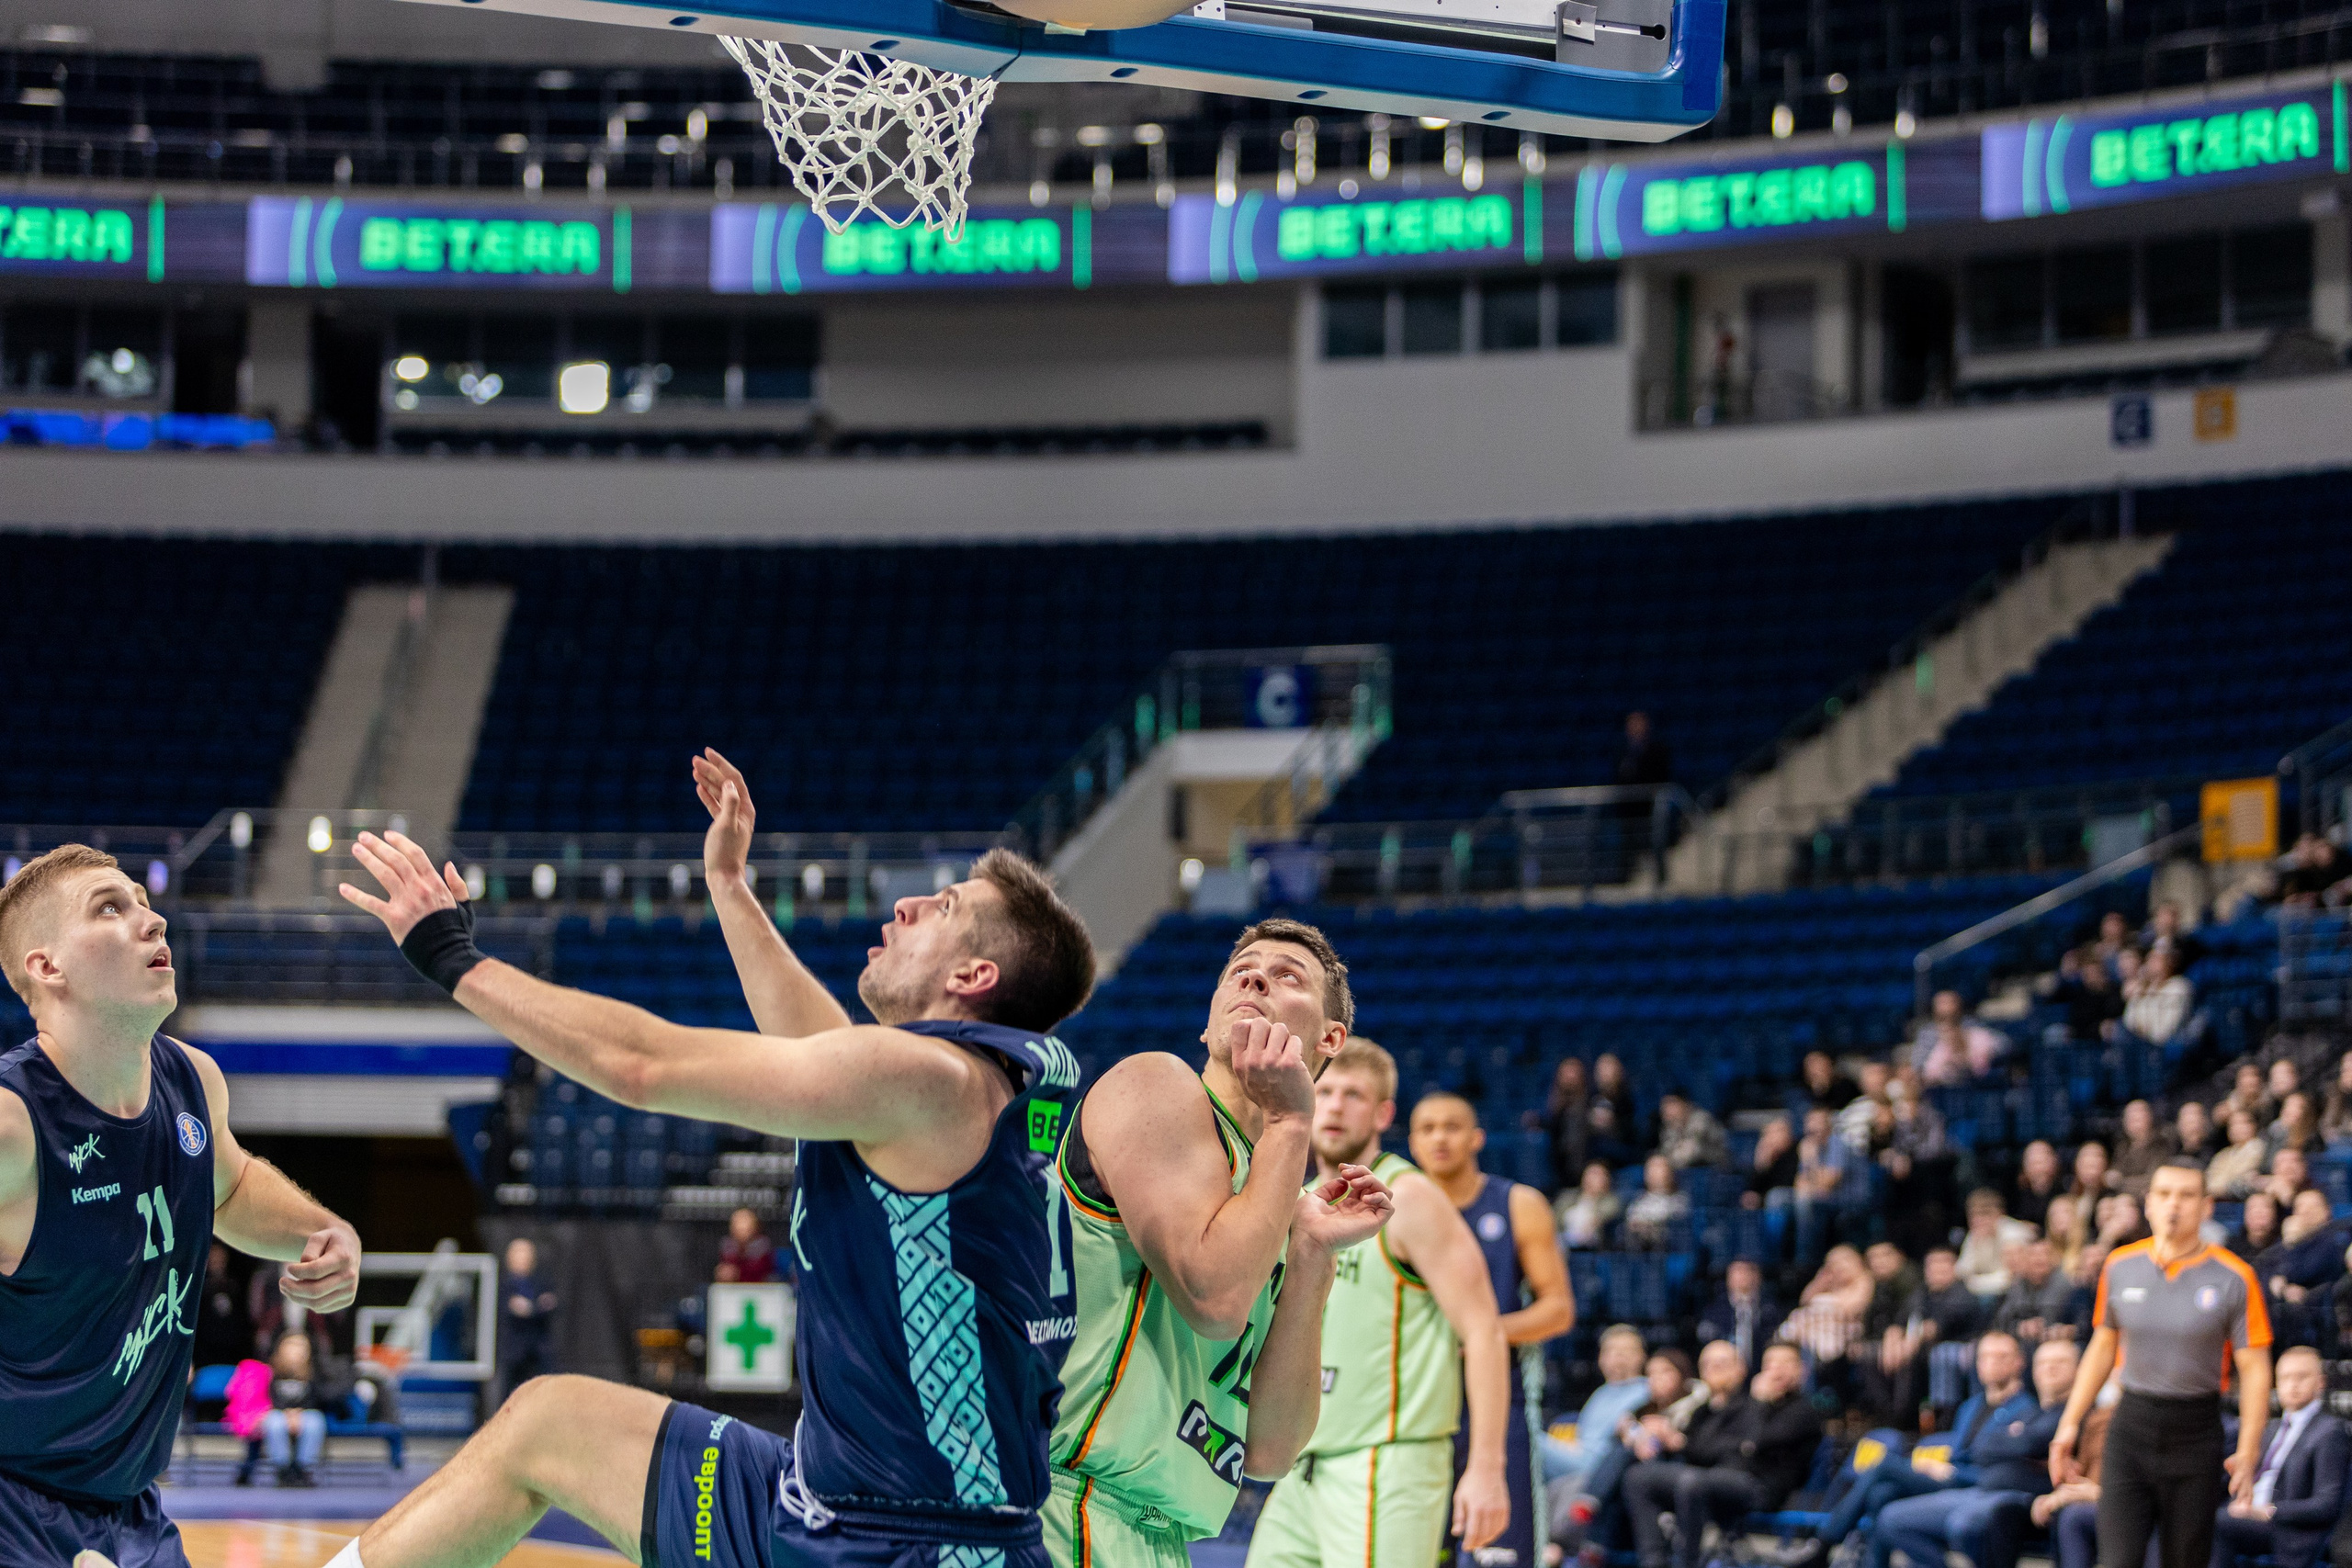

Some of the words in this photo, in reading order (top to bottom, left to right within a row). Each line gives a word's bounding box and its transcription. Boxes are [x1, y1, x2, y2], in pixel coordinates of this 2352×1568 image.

[2090, 101, 2320, 189] BETERA
[1276, 195, 1513, 261] BETERA
[1642, 161, 1876, 237] BETERA
[359, 217, 600, 275] BETERA
[72, 1182, 121, 1204] Kempa
[136, 1185, 175, 1261] 11
[694, 1447, 719, 1562] евроопт
